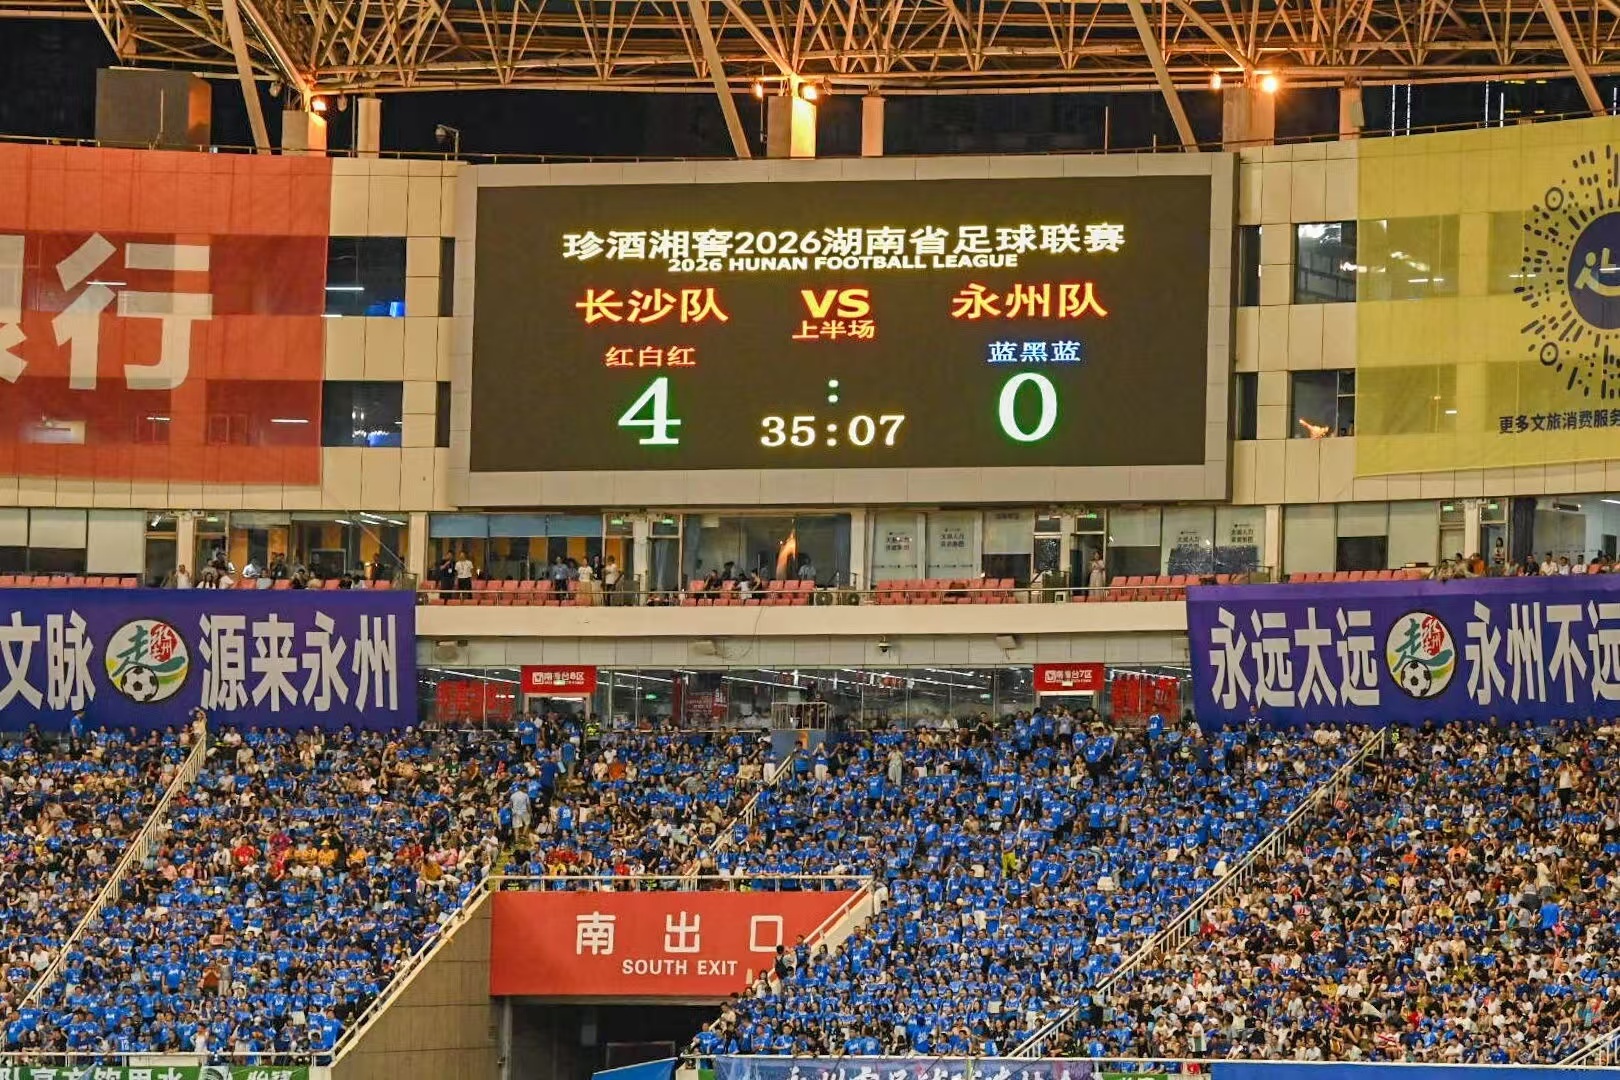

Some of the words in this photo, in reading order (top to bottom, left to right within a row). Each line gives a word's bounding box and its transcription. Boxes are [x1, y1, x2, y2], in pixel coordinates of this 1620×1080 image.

[562, 222, 1126, 261] 珍酒湘窖2026湖南省足球联赛
[668, 258, 722, 272] 2026
[729, 257, 808, 271] HUNAN
[815, 255, 927, 271] FOOTBALL
[933, 253, 1018, 268] LEAGUE
[0, 232, 213, 390] 行
[575, 288, 729, 323] 长沙队
[801, 289, 870, 318] VS
[951, 282, 1108, 319] 永州队
[792, 320, 875, 339] 上半场
[605, 346, 696, 367] 红白红
[987, 340, 1081, 363] 蓝黑蓝
[618, 377, 681, 445] 4
[999, 372, 1057, 442] 0
[1499, 408, 1620, 434] 更多文旅消费服务
[760, 415, 905, 447] 35:07
[0, 610, 96, 711] 文脉
[198, 610, 399, 712] 源来永州
[1209, 606, 1380, 709] 永远太远
[1465, 600, 1620, 706] 永州不远
[576, 911, 783, 955] 南出口
[622, 959, 687, 975] SOUTH
[697, 960, 738, 976] EXIT
